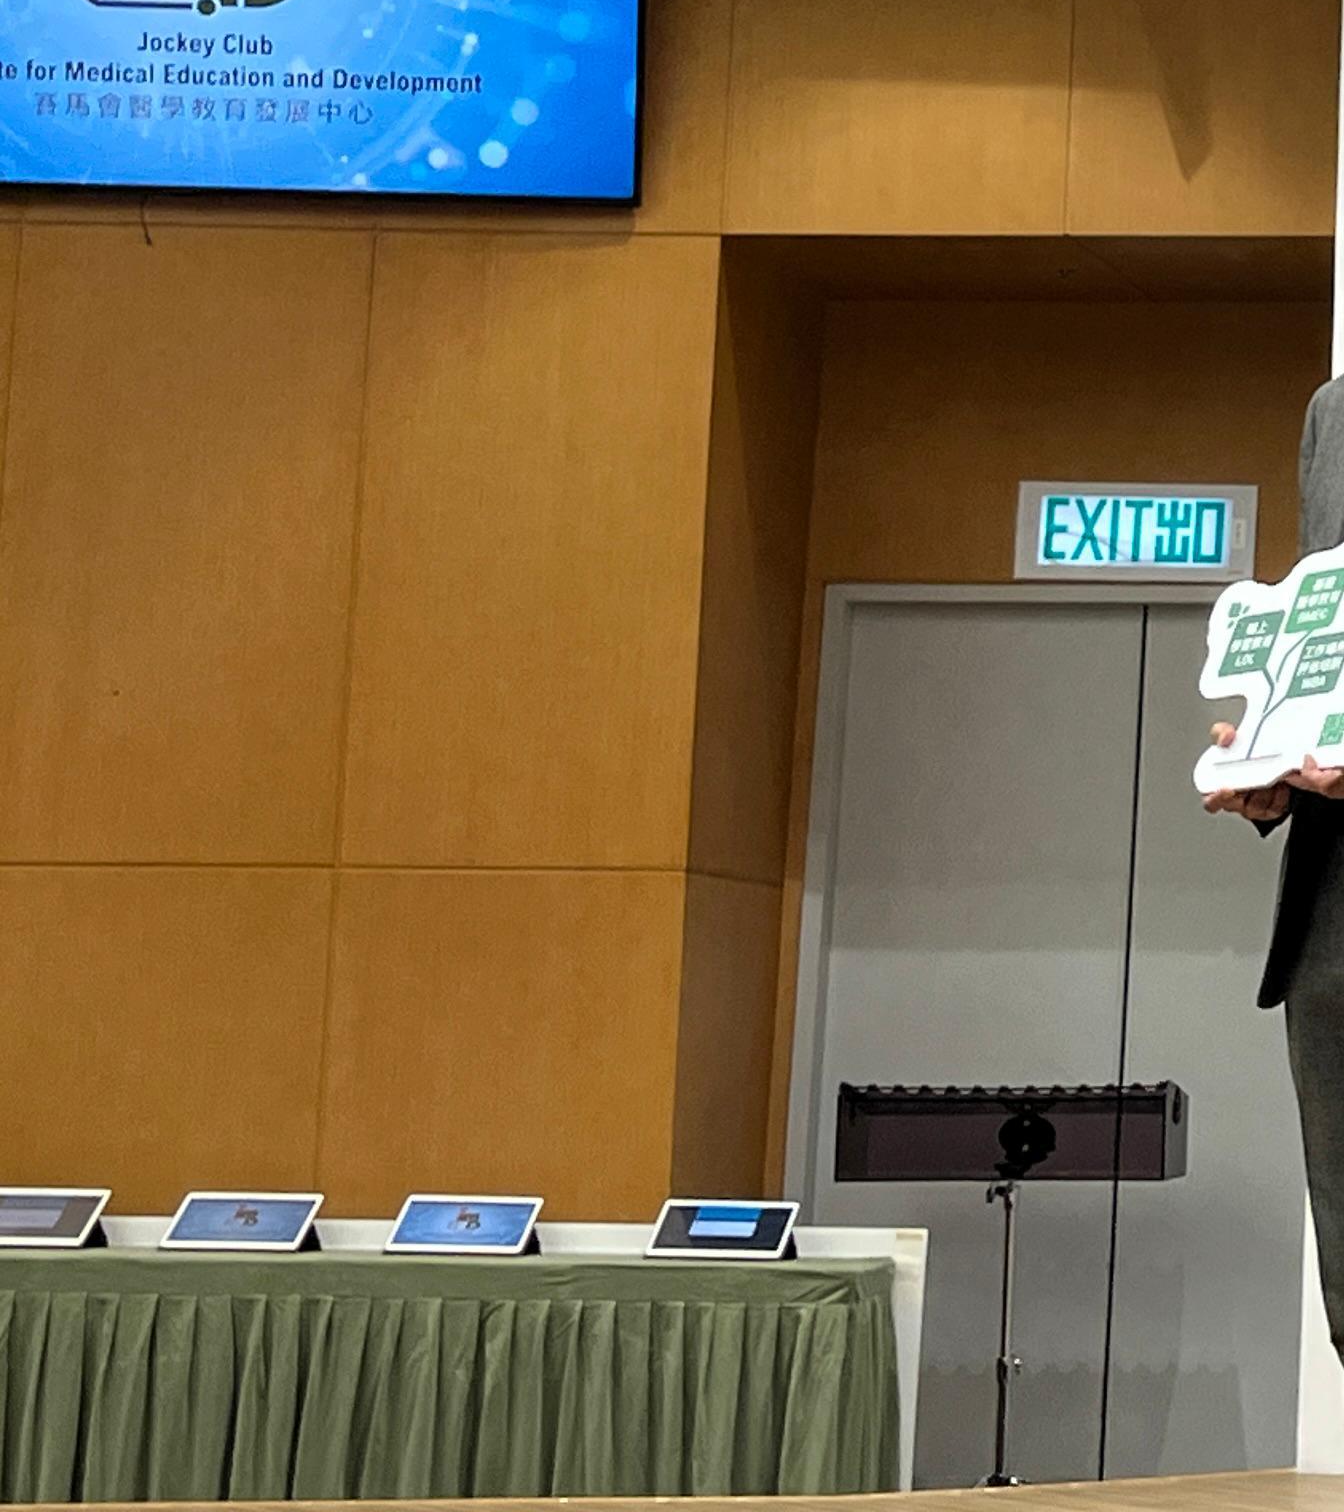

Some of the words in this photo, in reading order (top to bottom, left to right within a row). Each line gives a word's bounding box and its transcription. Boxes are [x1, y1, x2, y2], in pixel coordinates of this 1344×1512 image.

[137, 32, 216, 58] Jockey
[223, 33, 273, 56] Club
[26, 58, 57, 81] for
[65, 61, 154, 84] Medical
[163, 64, 274, 88] Education
[283, 68, 324, 89] and
[332, 70, 482, 95] Development
[1043, 497, 1153, 563] EXIT
